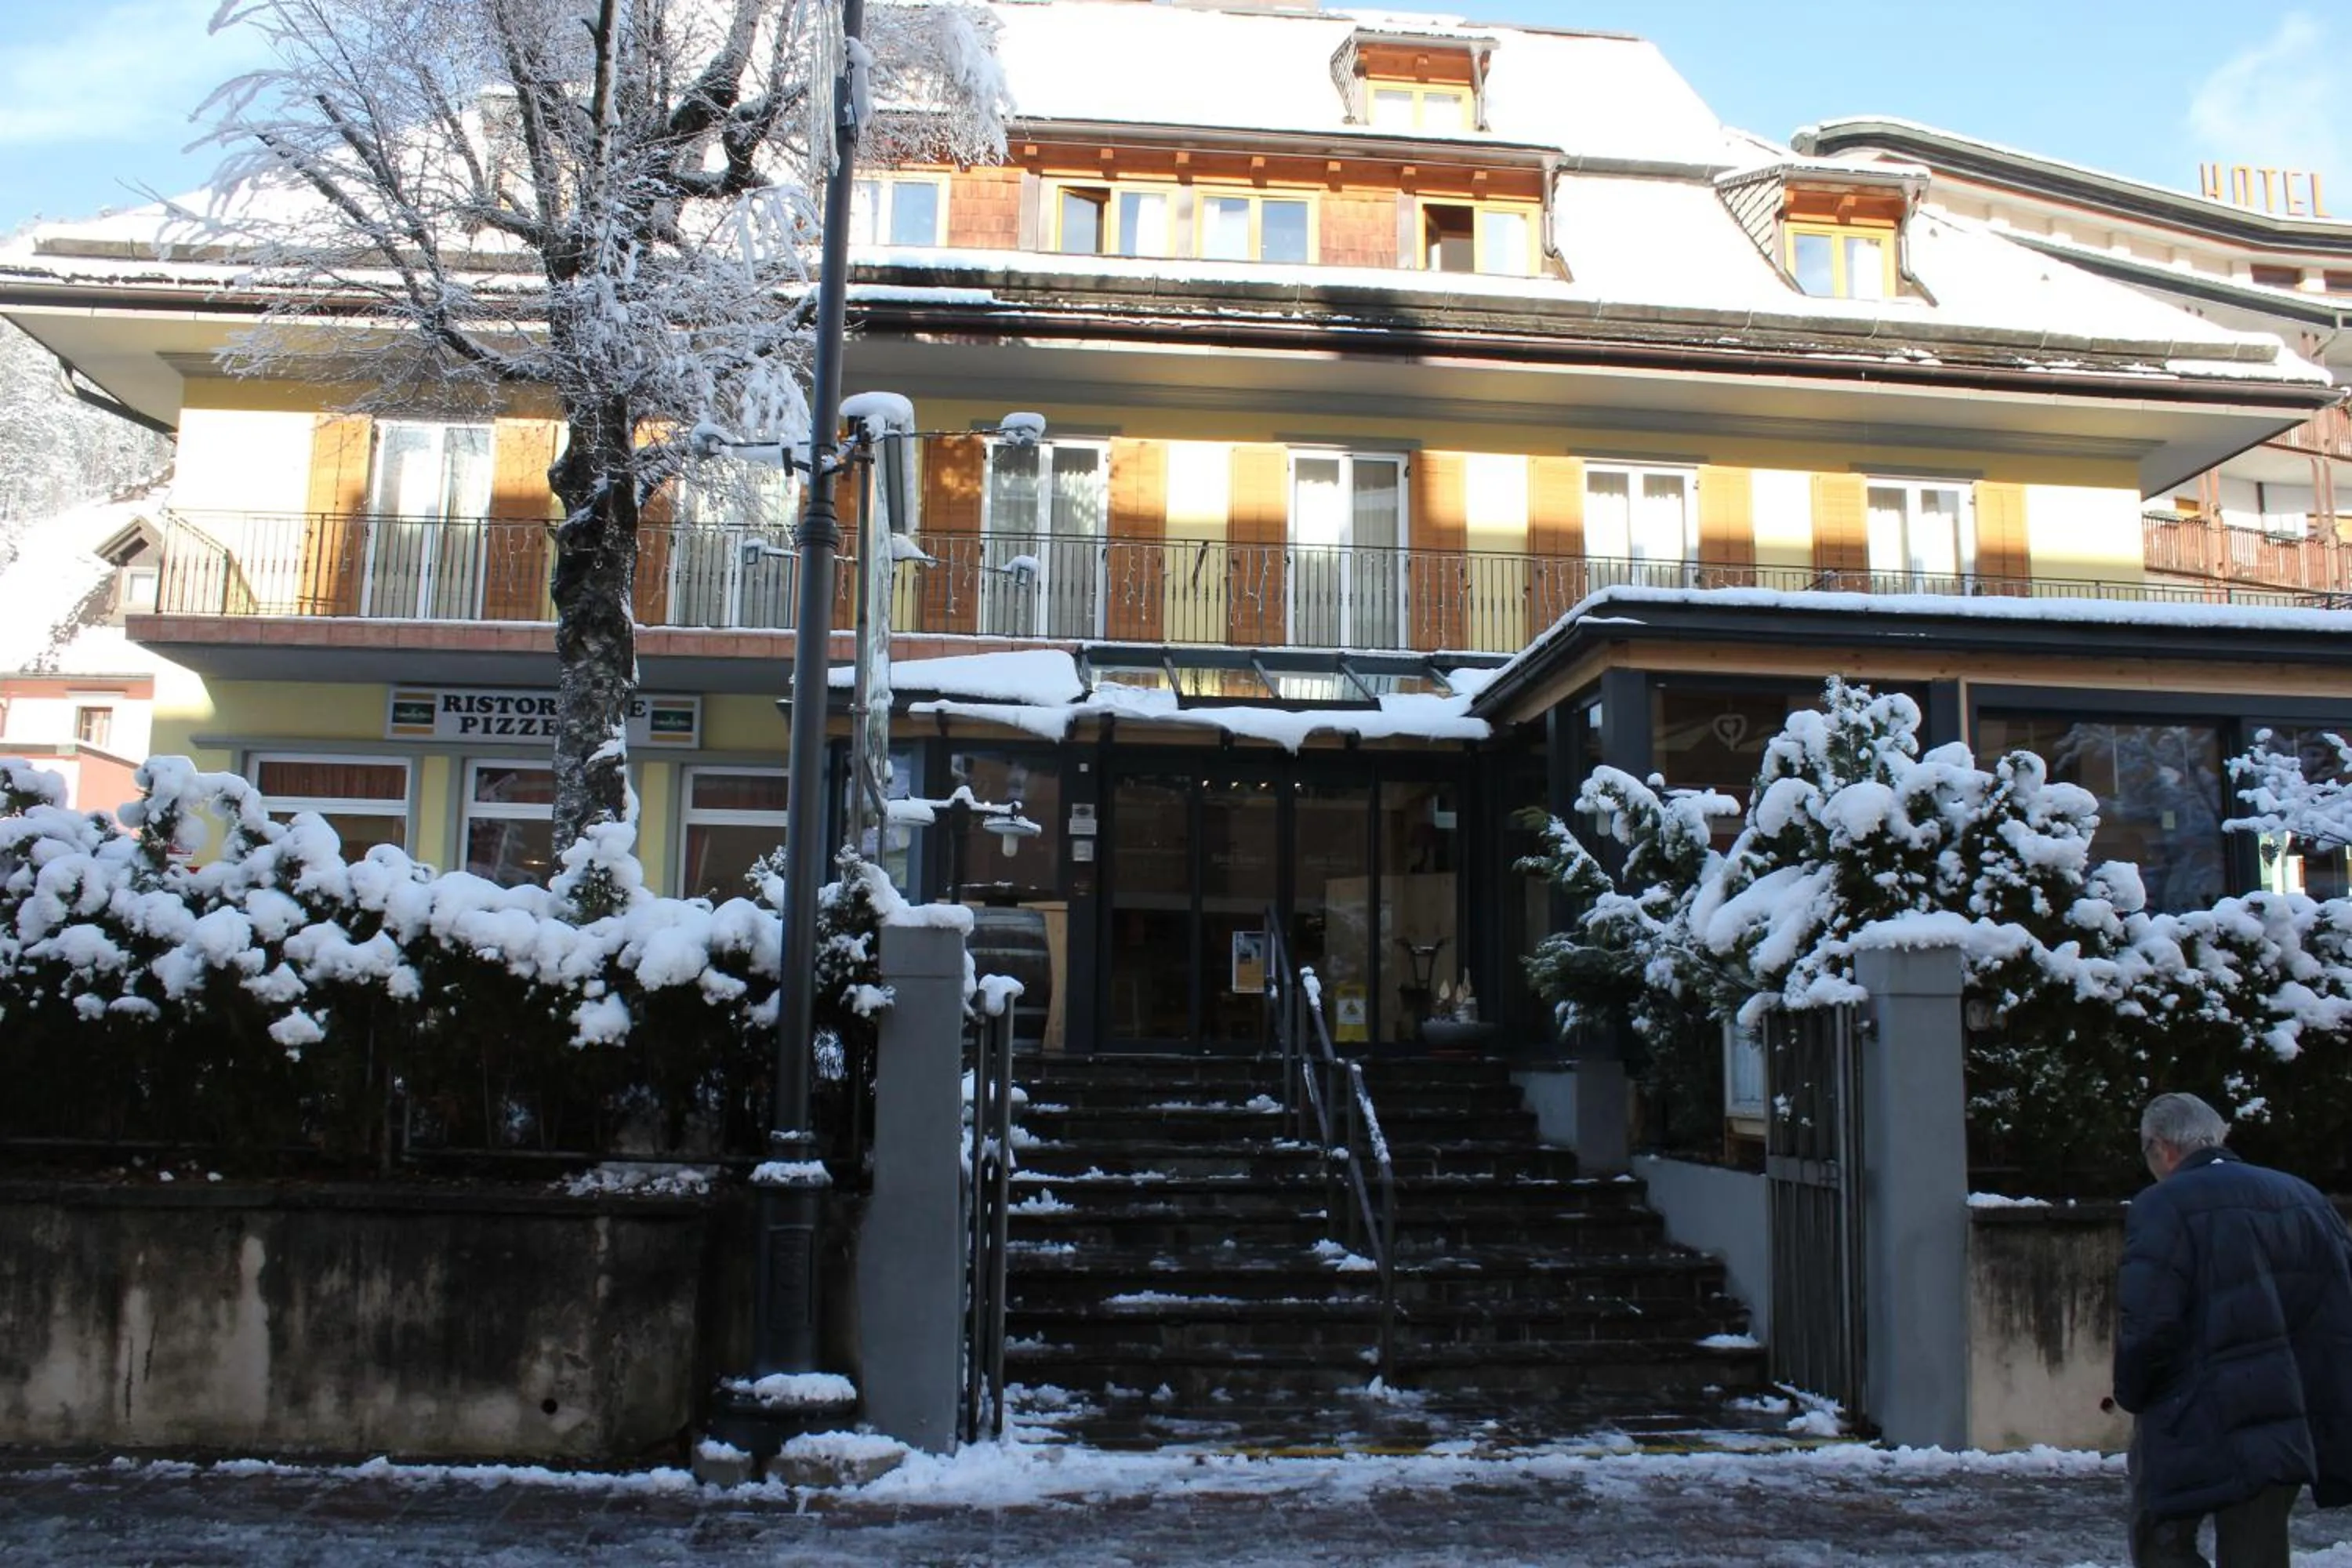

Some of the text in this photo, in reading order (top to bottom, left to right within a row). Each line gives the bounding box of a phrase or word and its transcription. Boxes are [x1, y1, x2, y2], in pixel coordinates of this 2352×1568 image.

[2200, 162, 2332, 218] HOTEL
[442, 695, 647, 717] RISTORE
[459, 717, 561, 736] PIZZE
